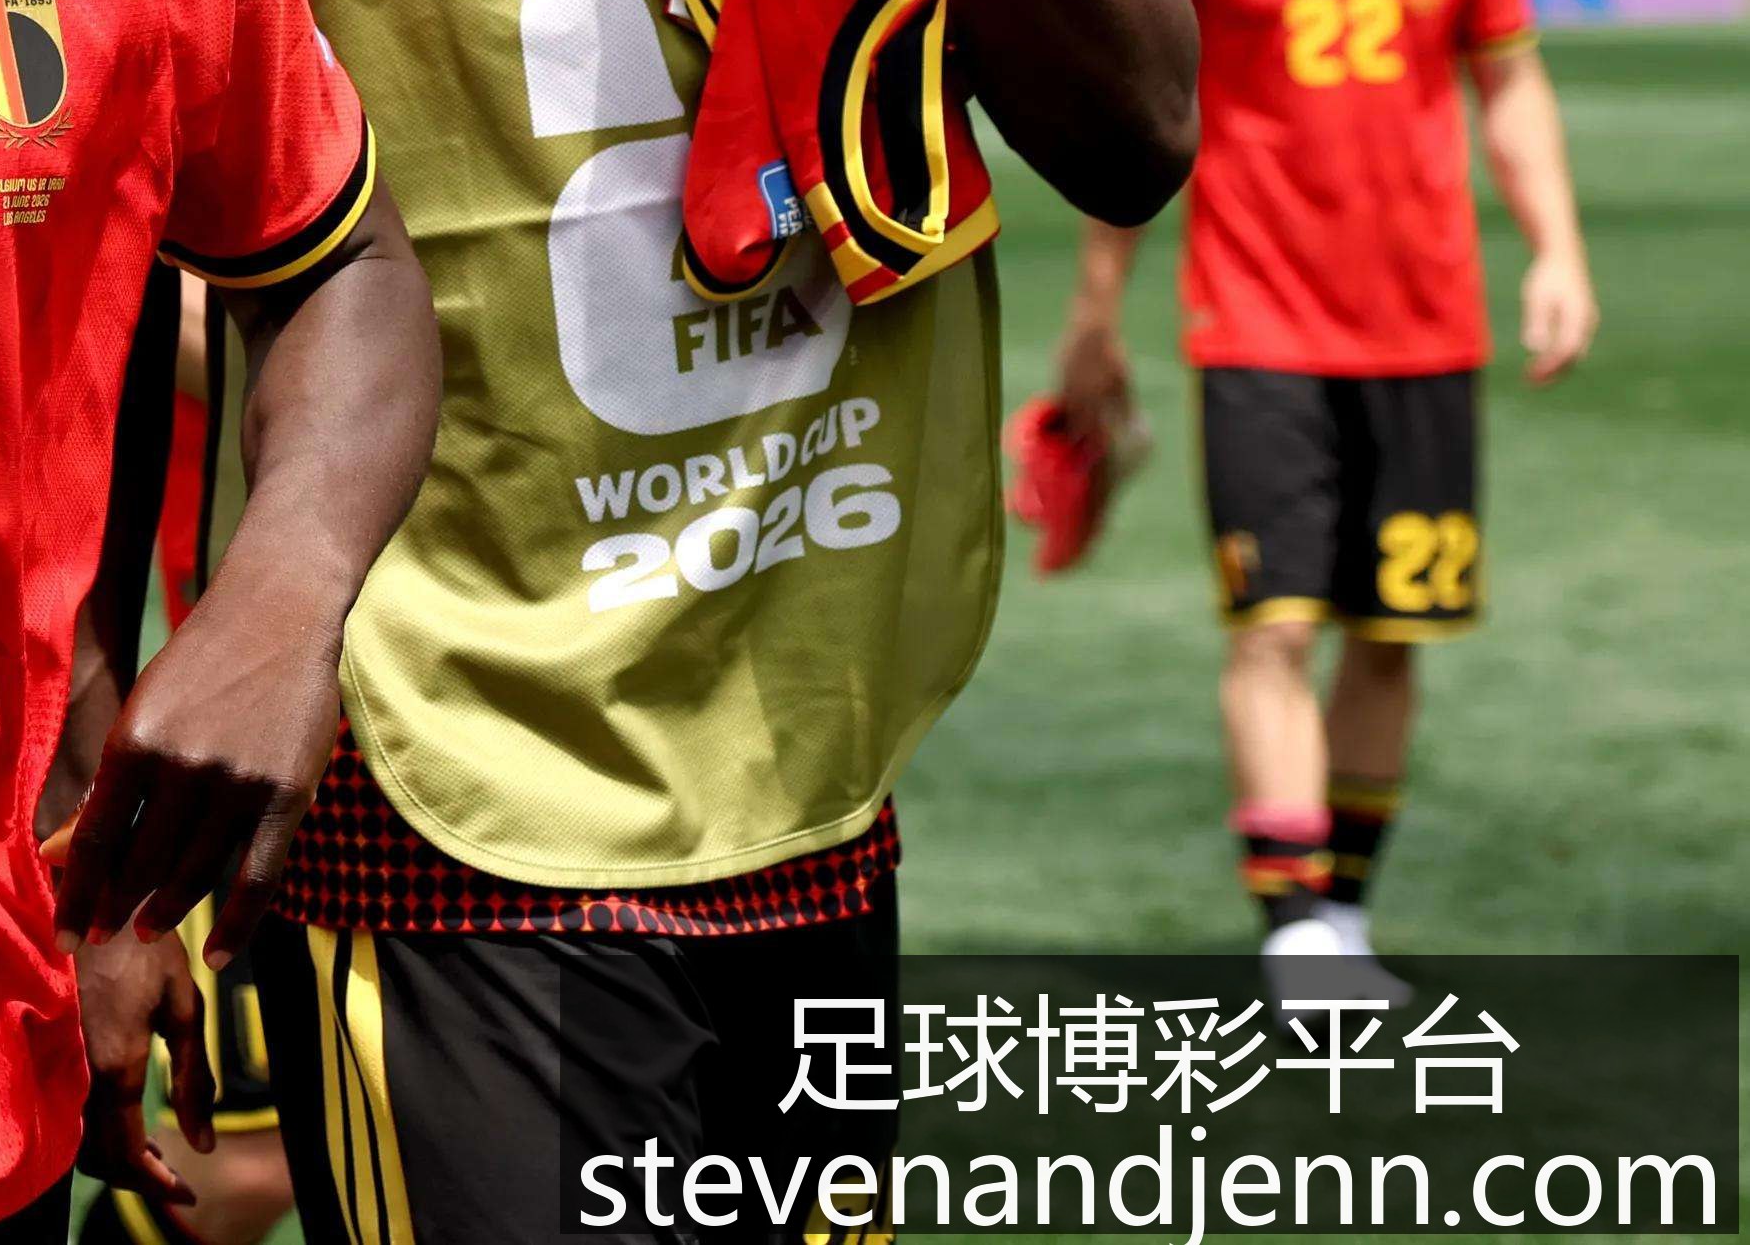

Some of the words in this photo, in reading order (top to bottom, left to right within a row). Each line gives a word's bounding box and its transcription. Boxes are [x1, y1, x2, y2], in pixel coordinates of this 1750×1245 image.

[672, 287, 825, 375] FIFA
[575, 432, 798, 524] WORLD
[800, 397, 882, 466] CUP
[581, 463, 902, 614] 2026
[1377, 510, 1478, 613] 22
